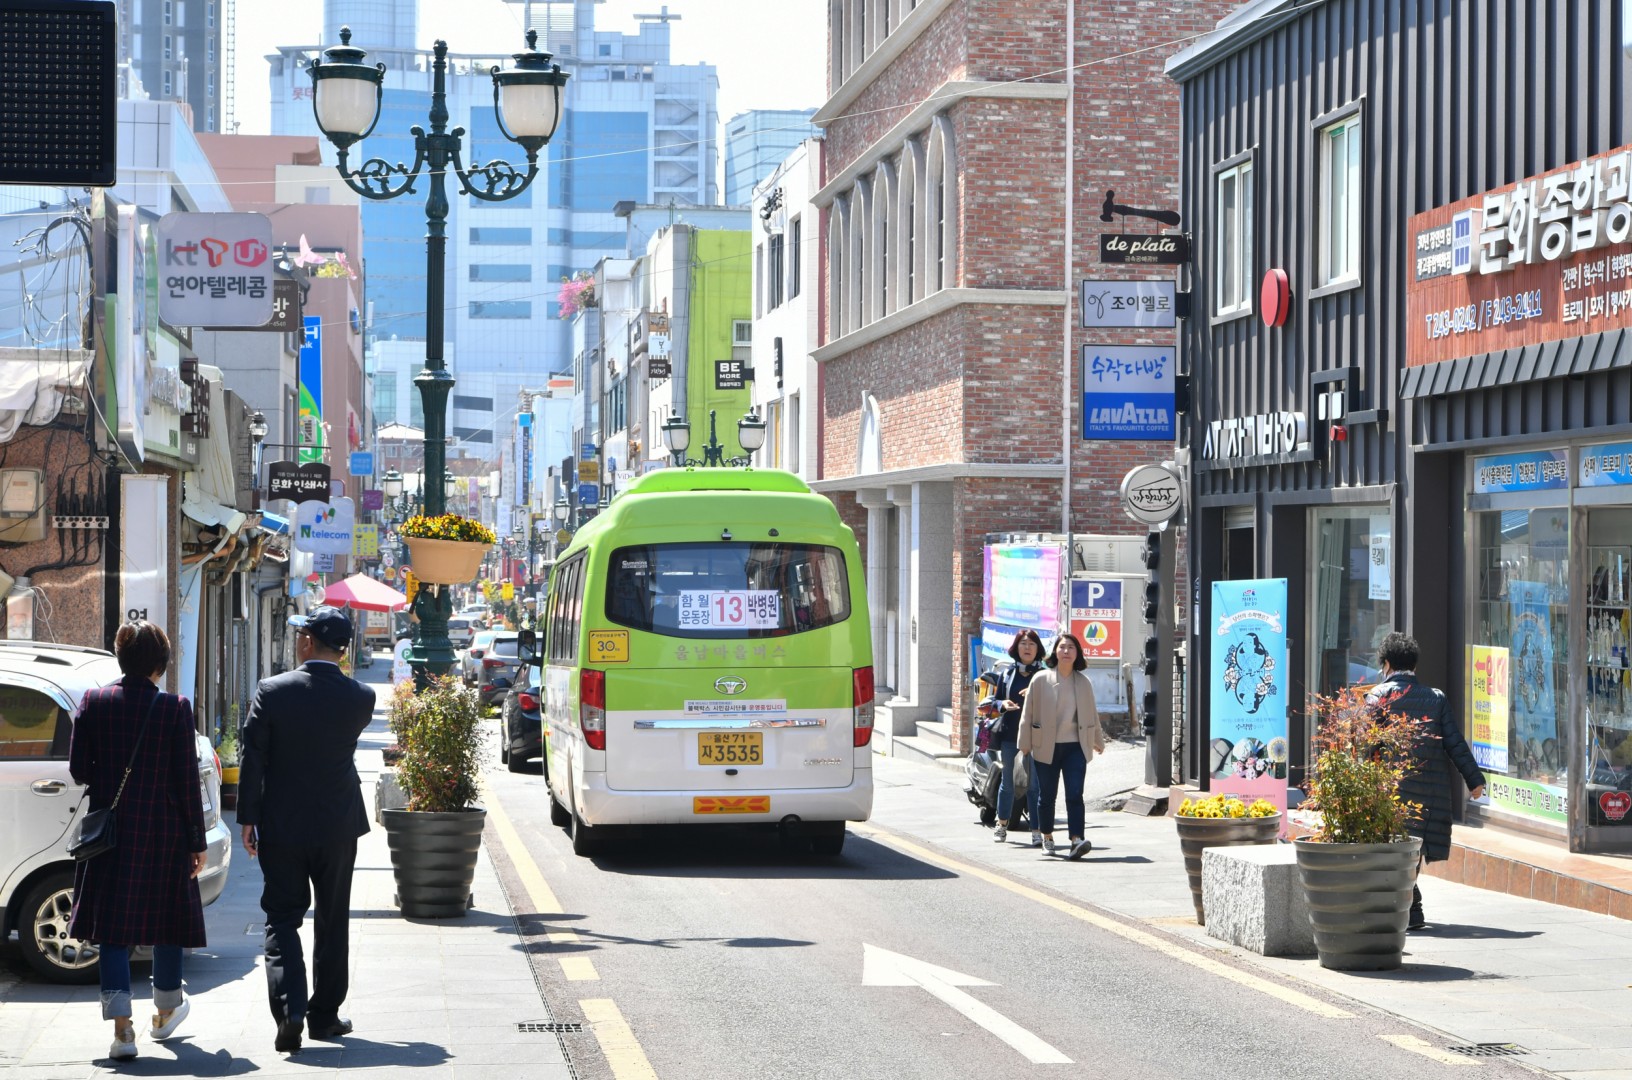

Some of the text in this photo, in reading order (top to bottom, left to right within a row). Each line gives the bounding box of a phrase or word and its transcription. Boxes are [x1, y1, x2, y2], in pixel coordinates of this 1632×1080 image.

[165, 239, 199, 266] kt
[1106, 236, 1176, 254] de plata
[1584, 260, 1604, 286] 현수막
[166, 276, 267, 298] 연아텔레콤
[1111, 296, 1171, 312] 조이엘로
[1563, 299, 1583, 322] 트로피
[1590, 295, 1604, 317] 모자
[719, 362, 740, 372] BE
[1092, 356, 1166, 381] 수작다방
[1089, 402, 1169, 424] LAVAZZA
[1481, 460, 1567, 486] 실사출력전문 현황판 철구조물
[1602, 454, 1620, 473] 트로피
[271, 479, 328, 493] 문화 인쇄사
[1088, 582, 1105, 607] P
[681, 610, 710, 625] 운동장
[715, 596, 743, 623] 13
[747, 594, 778, 619] 박병원
[1076, 609, 1117, 617] 유료주차장
[597, 640, 615, 652] 30
[714, 734, 746, 743] 울산 71
[702, 745, 760, 762] 자 3535
[1492, 782, 1509, 800] 현수막
[1515, 788, 1533, 807] 현황판
